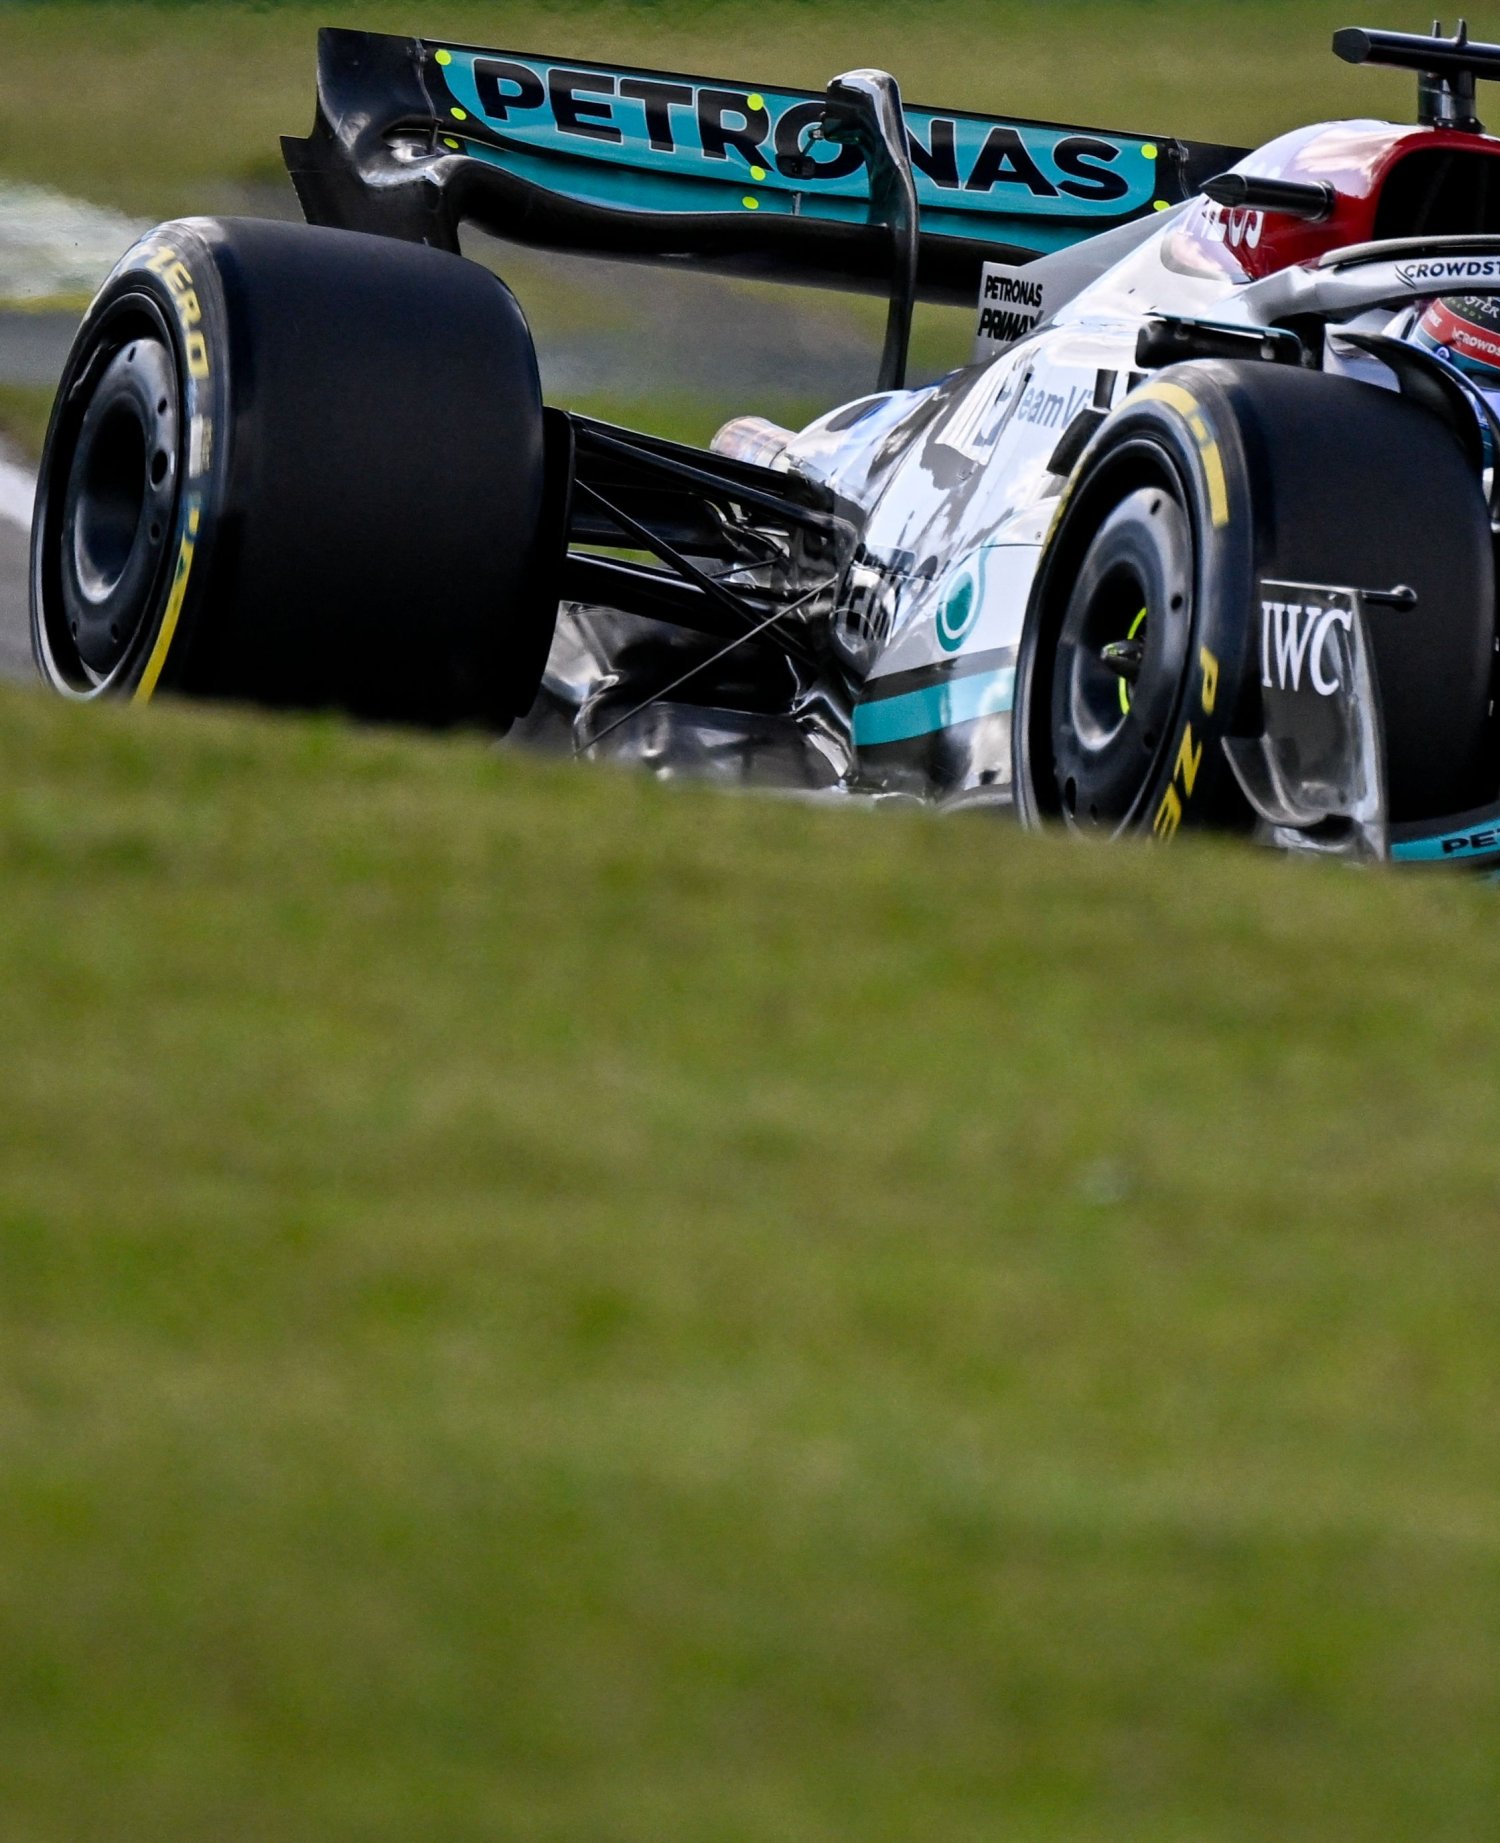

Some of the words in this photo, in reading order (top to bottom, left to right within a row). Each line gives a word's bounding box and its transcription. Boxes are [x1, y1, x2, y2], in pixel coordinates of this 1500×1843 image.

[473, 56, 1130, 201] PETRONAS
[144, 246, 210, 379] ZERO
[984, 275, 1043, 307] PETRONAS
[1262, 601, 1353, 696] IWC
